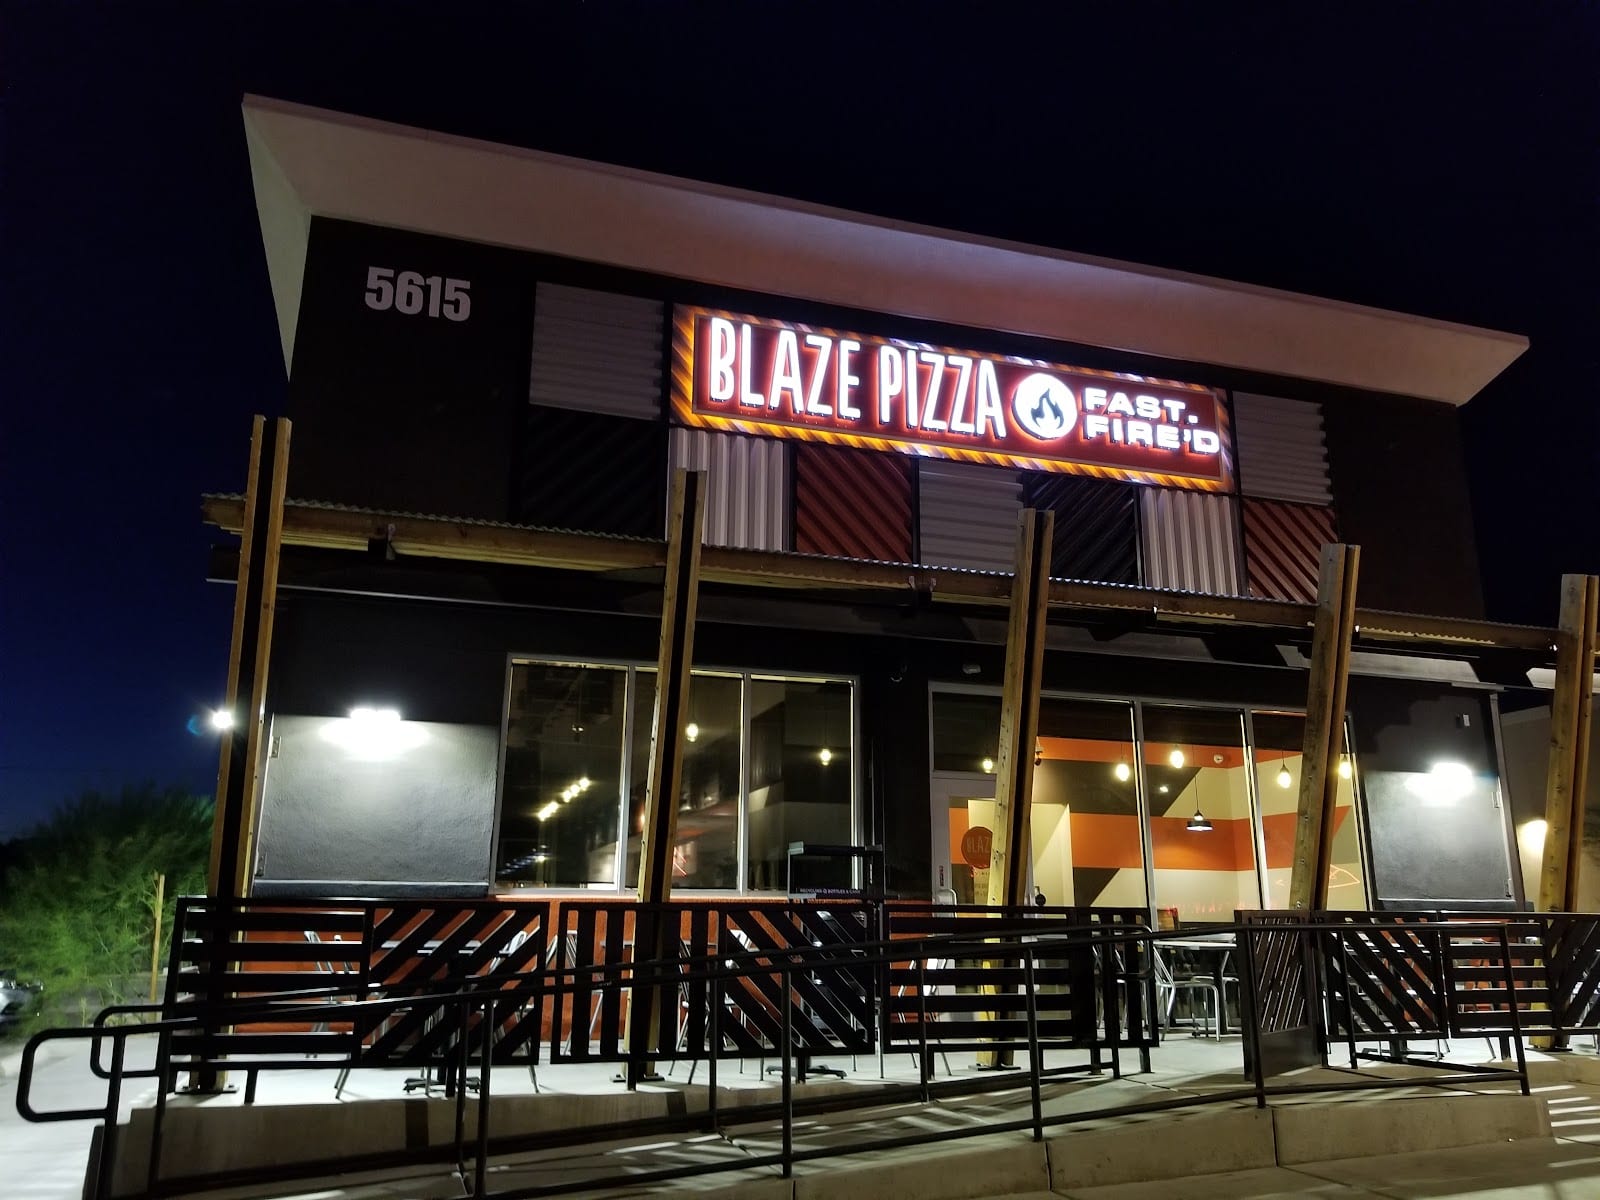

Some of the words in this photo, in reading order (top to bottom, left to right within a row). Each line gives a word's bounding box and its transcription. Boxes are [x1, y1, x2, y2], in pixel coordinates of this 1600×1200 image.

[365, 266, 471, 321] 5615
[710, 317, 861, 419] BLAZE
[880, 345, 1007, 439] PIZZA
[1085, 387, 1198, 425] FAST.
[1086, 414, 1220, 454] FIRE'D
